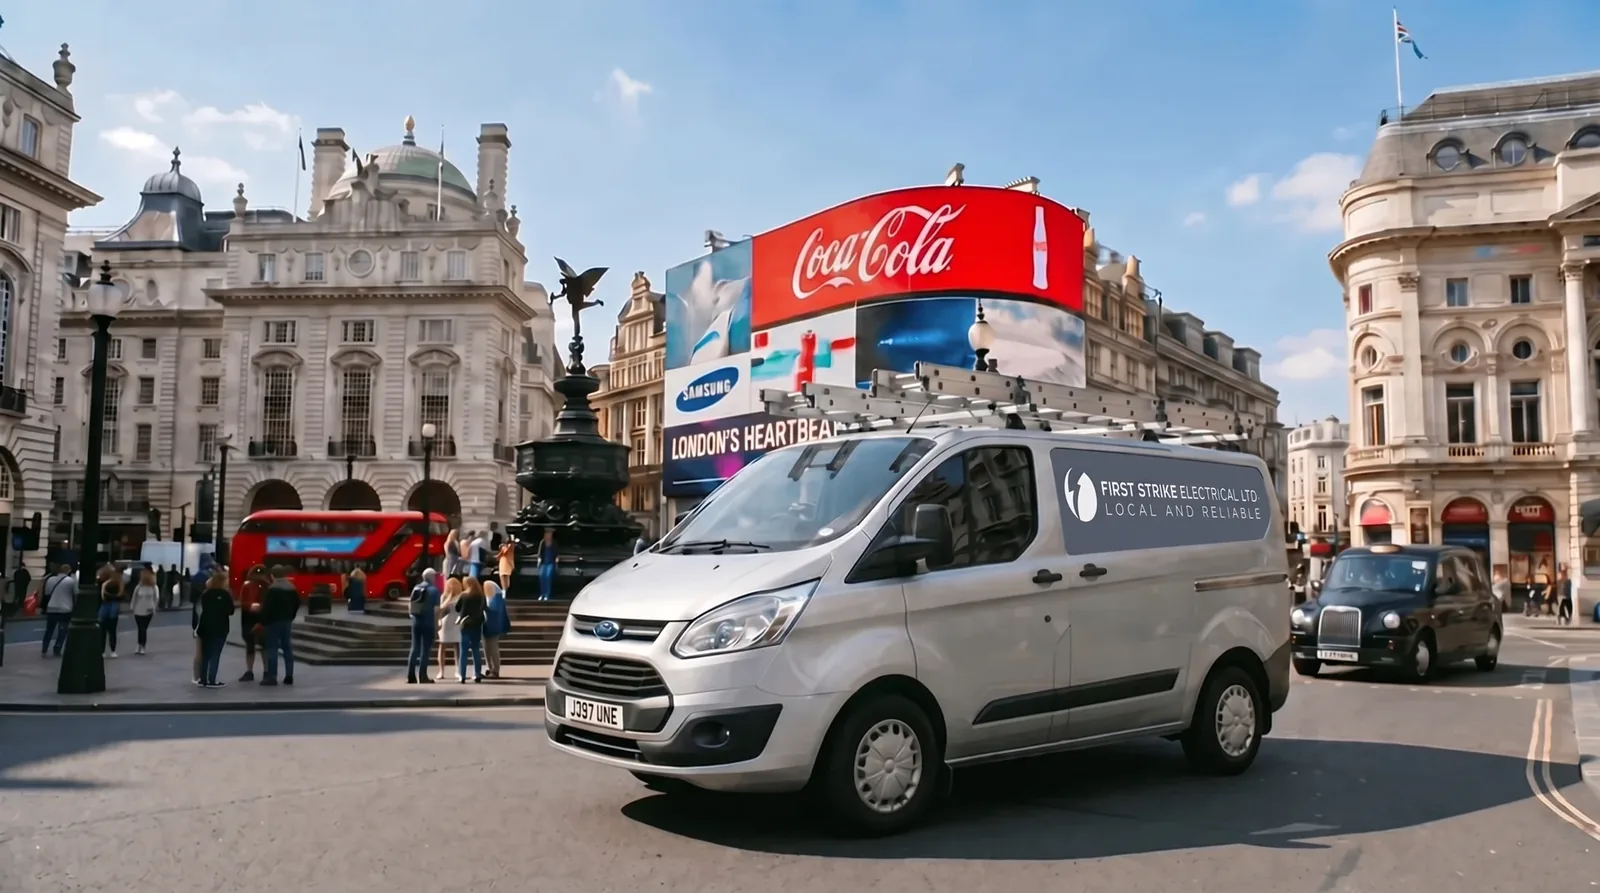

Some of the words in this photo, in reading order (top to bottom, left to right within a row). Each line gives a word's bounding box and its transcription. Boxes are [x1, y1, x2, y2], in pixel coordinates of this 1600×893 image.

[792, 204, 967, 299] Coca-Cola
[682, 379, 731, 401] SAMSUNG
[672, 427, 740, 460] LONDON'S
[1100, 481, 1134, 497] FIRST
[1137, 483, 1178, 499] STRIKE
[1179, 485, 1239, 502] ELECTRICAL
[1105, 502, 1157, 517] LOCAL
[1165, 504, 1194, 518] AND
[1201, 505, 1261, 520] RELIABLE
[596, 704, 618, 725] UNE
